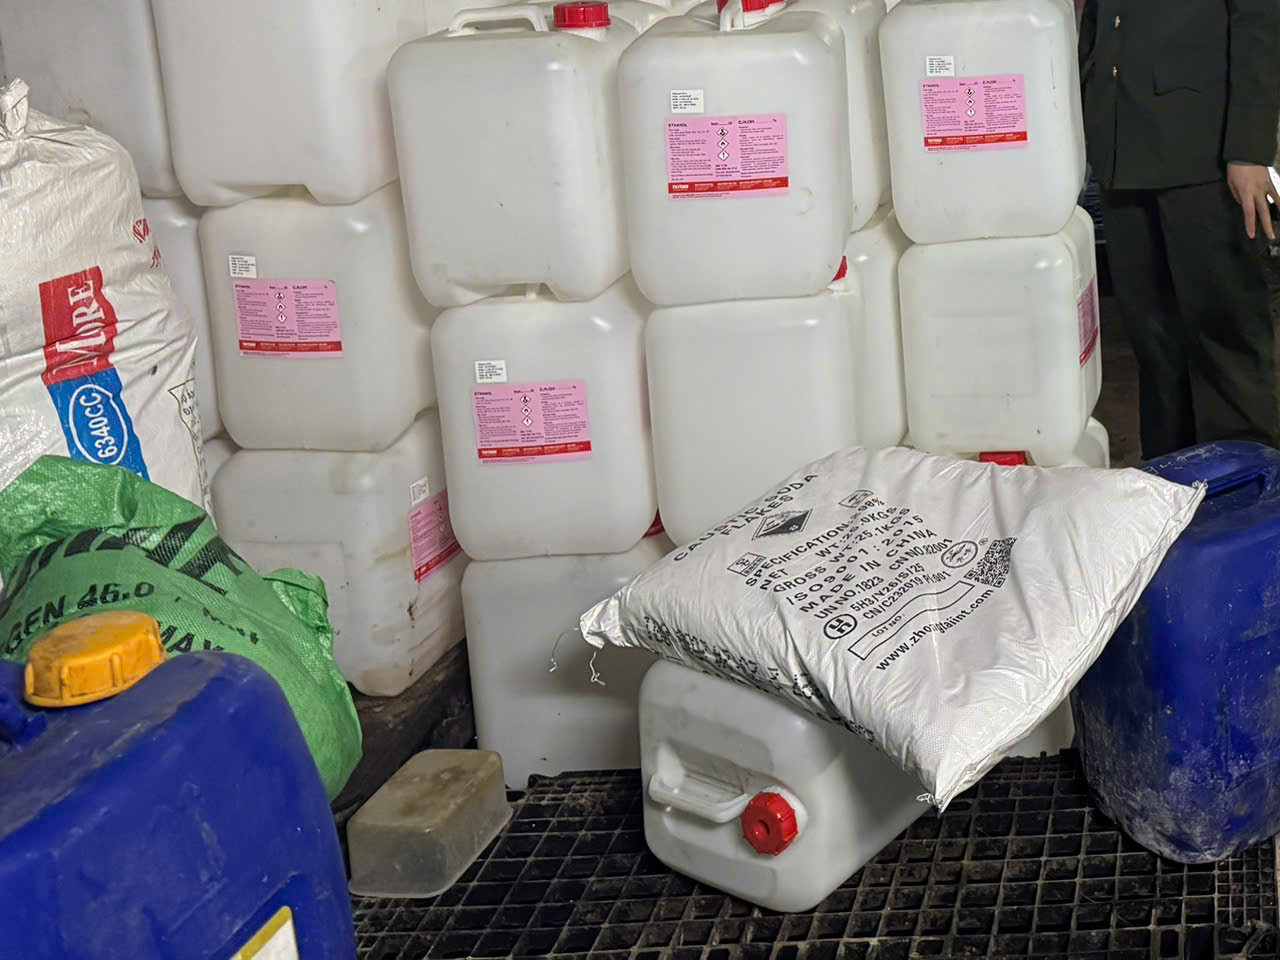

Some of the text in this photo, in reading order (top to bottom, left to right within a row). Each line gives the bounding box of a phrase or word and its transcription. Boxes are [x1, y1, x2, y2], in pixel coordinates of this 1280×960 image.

[79, 391, 119, 459] 6340CC
[673, 474, 819, 562] CAUSTIC SODA
[719, 494, 794, 536] FLAKES
[773, 565, 827, 593] GROSS
[829, 507, 911, 564] WT:25.1KGS
[799, 528, 938, 614] MADE IN CHINA
[77, 581, 155, 610] 46.0
[760, 568, 789, 590] NET
[863, 576, 925, 620] CN/C232019
[872, 625, 889, 638] LOT
